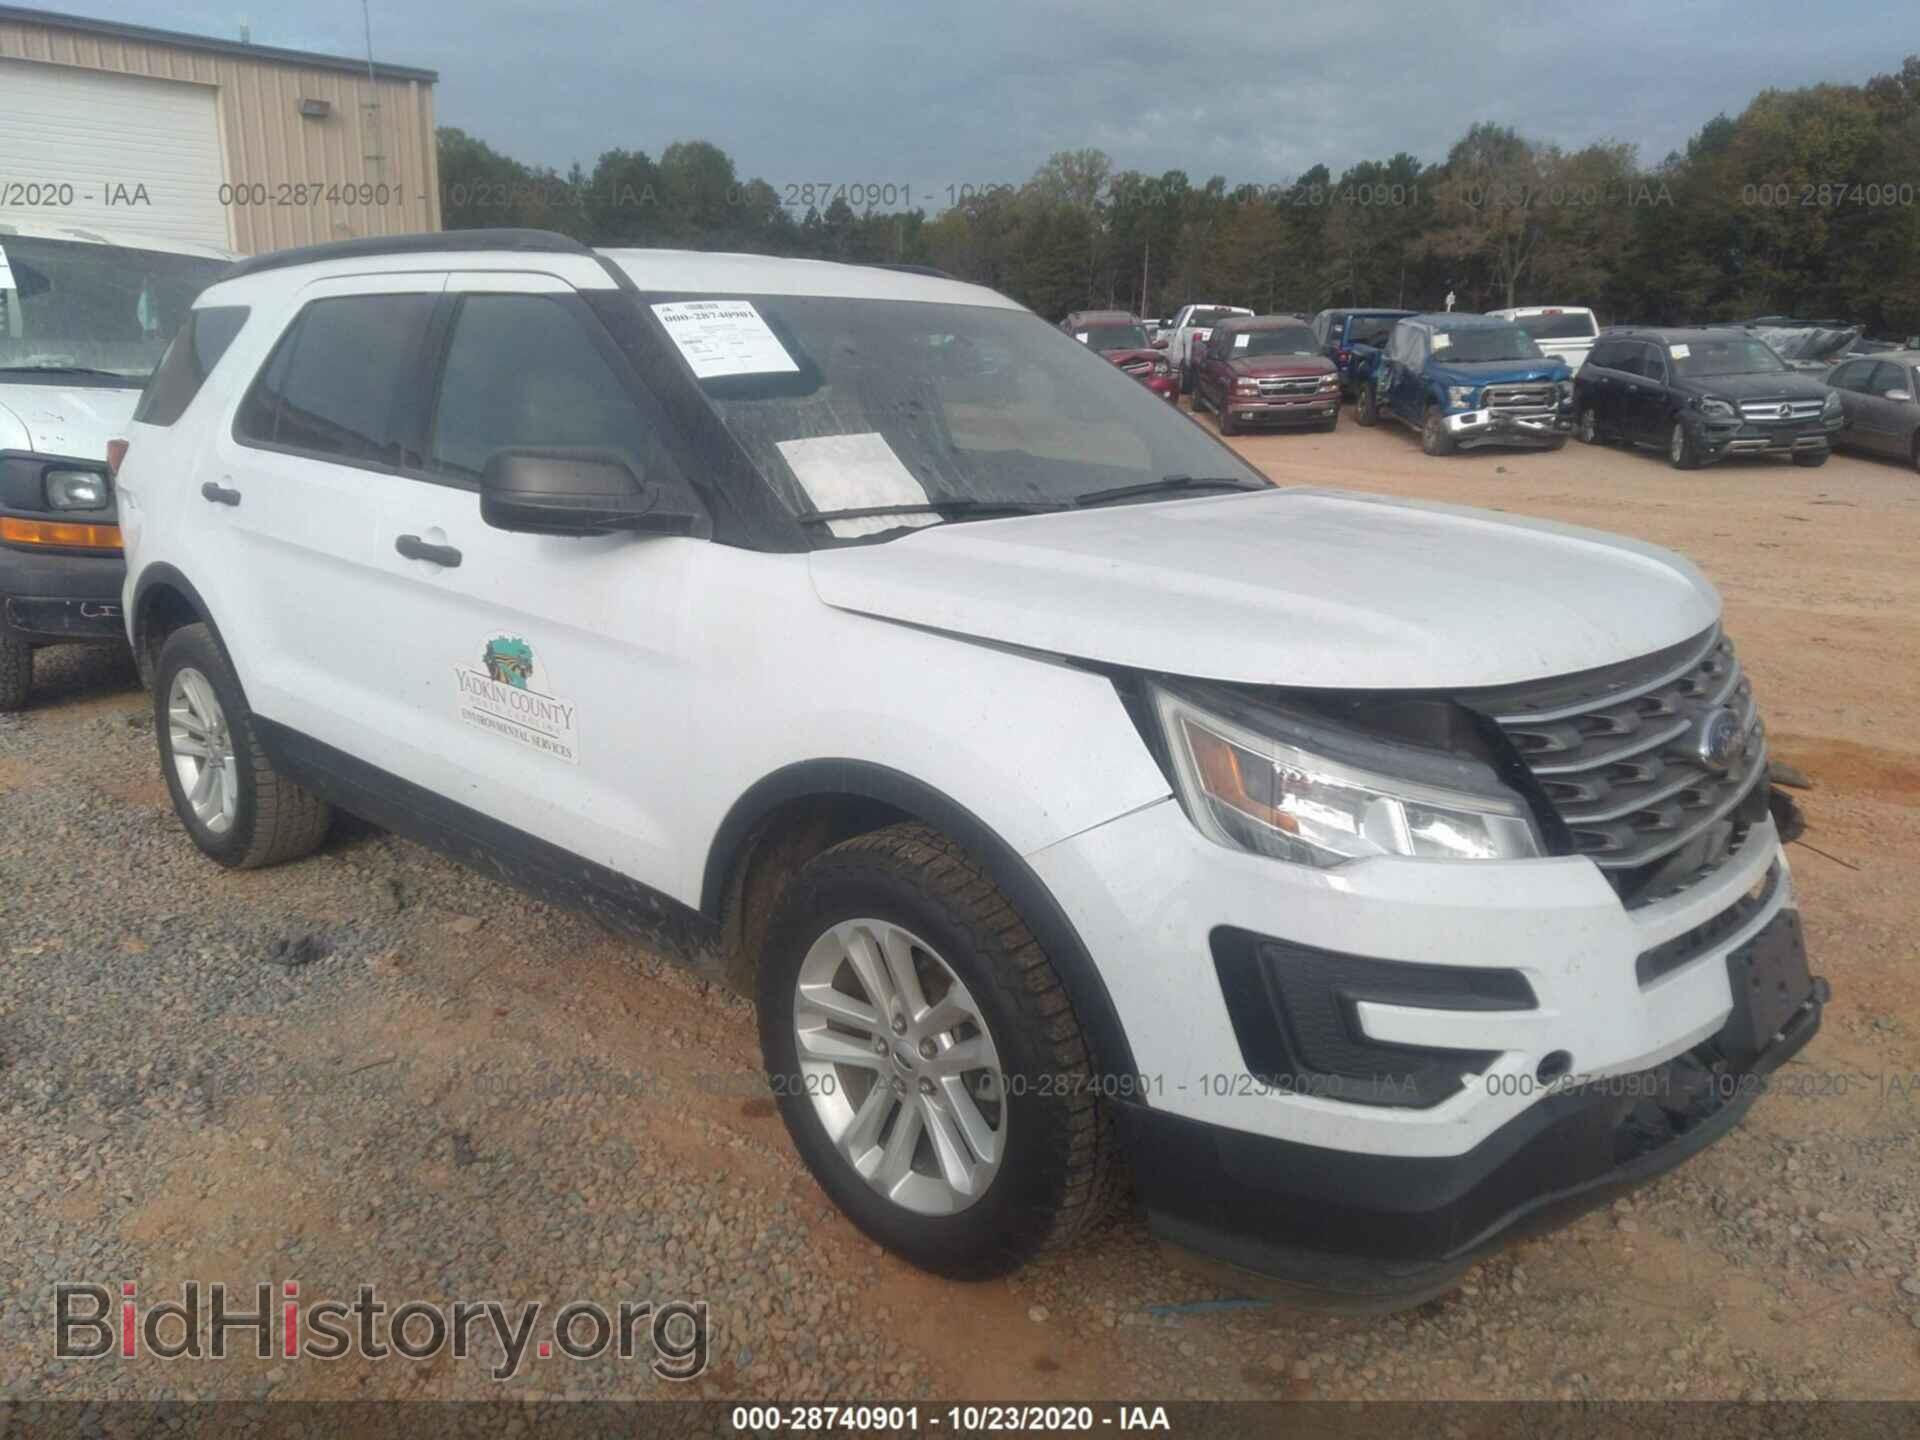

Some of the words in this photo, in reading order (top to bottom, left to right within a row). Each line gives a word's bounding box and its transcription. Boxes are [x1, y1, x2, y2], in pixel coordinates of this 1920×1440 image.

[455, 668, 507, 704] YADKIN
[510, 691, 574, 730] COUNTY
[461, 708, 530, 743] ENVIRONMENTAL
[531, 736, 573, 759] SERVICES
